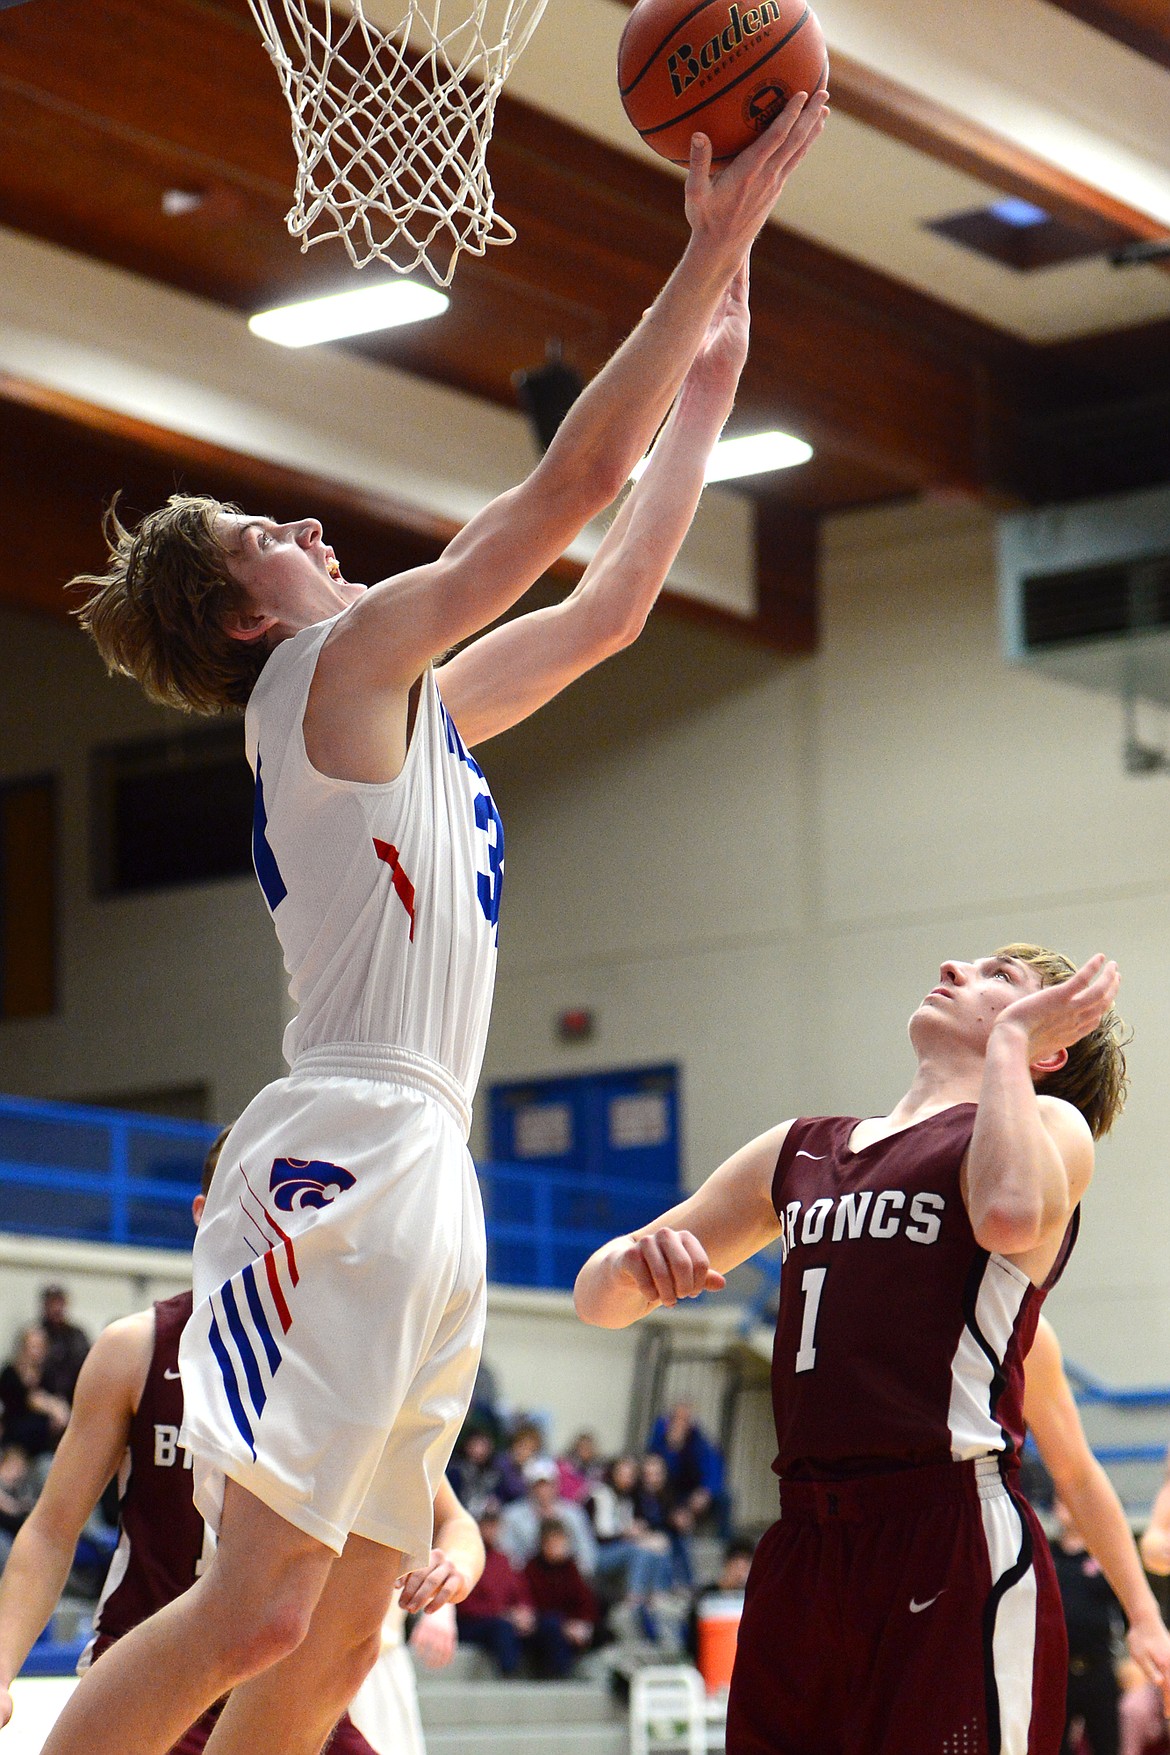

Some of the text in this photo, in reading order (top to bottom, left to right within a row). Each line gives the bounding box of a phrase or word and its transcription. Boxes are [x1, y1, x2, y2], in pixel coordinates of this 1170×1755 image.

[666, 0, 780, 98] Baden
[699, 29, 774, 88] PERFECTION
[474, 791, 505, 947] 3
[795, 1267, 827, 1374] 1
